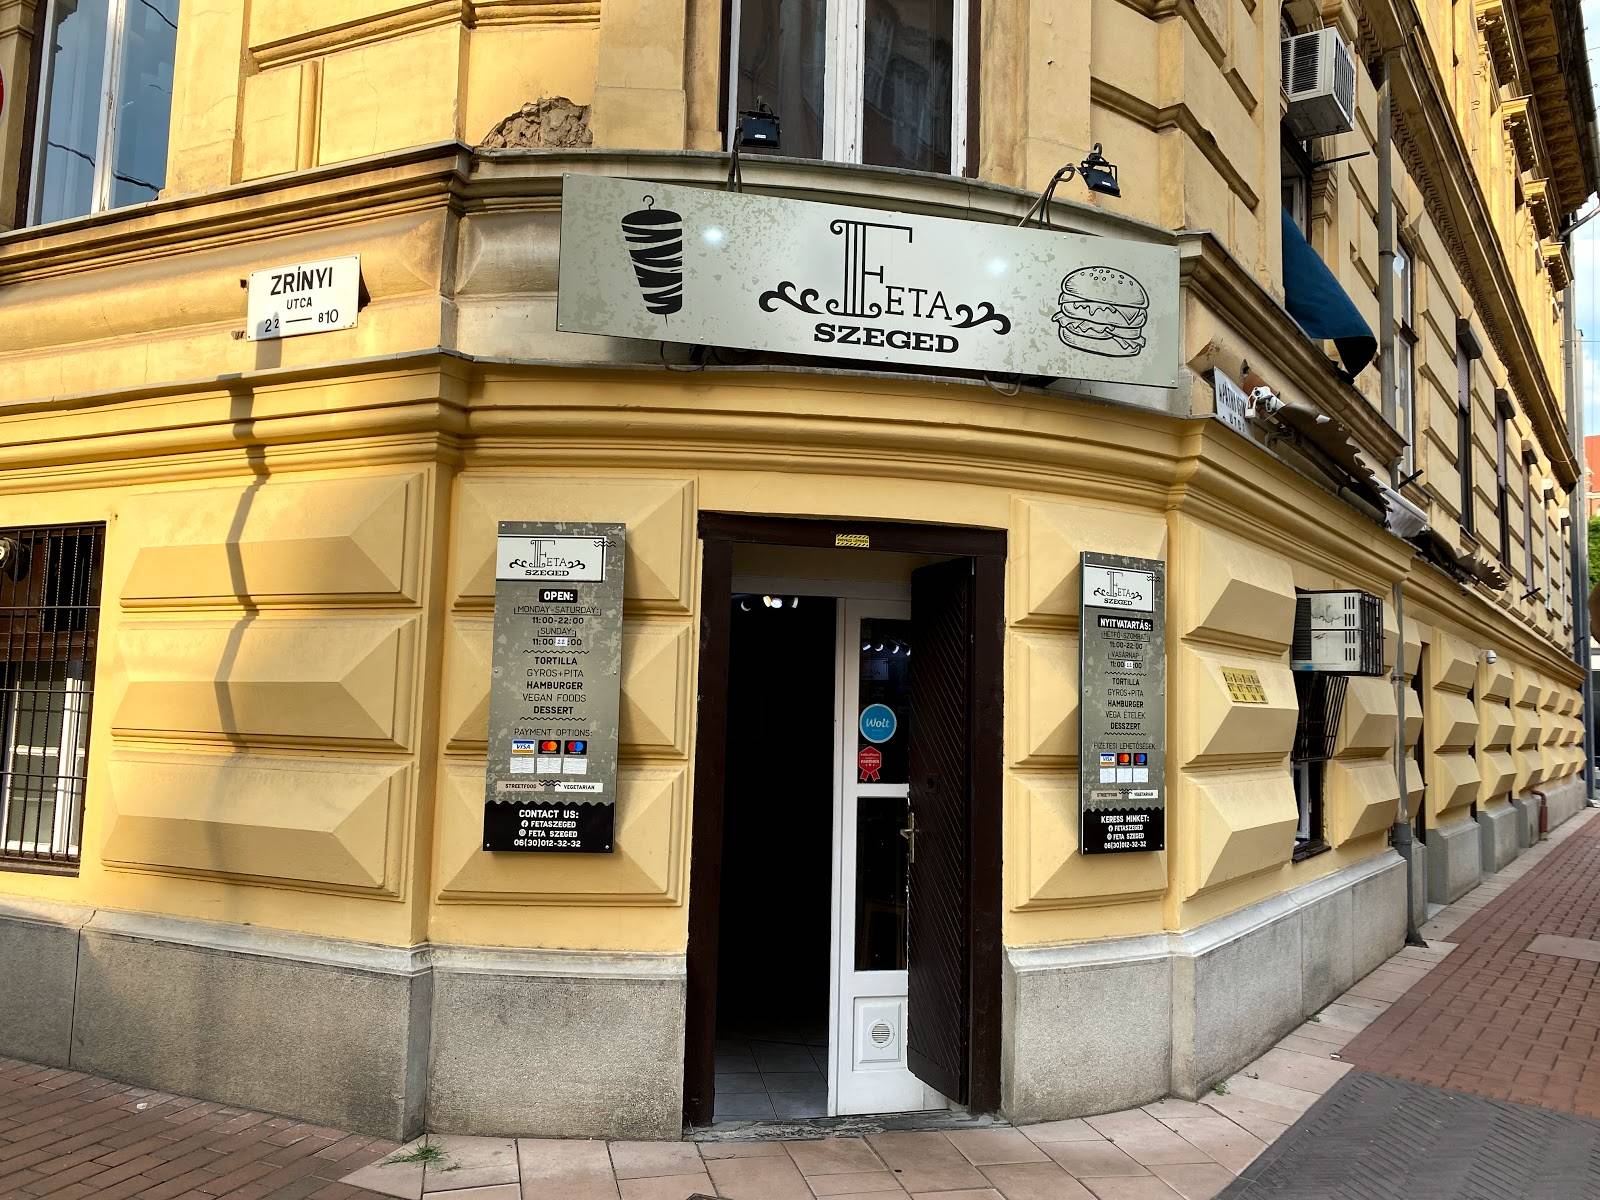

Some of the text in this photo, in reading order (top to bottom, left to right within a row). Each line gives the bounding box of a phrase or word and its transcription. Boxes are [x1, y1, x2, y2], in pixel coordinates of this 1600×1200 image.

[826, 219, 952, 320] FETA
[270, 266, 333, 296] ZRÍNYI
[286, 297, 313, 310] UTCA
[813, 322, 959, 353] SZEGED
[543, 591, 574, 601] OPEN:
[1103, 597, 1133, 606] SZEGED
[1100, 617, 1152, 631] NYITVATARTÁS:
[534, 656, 578, 665] TORTILLA
[526, 669, 584, 678] GYROS+PITA
[526, 681, 583, 690] HAMBURGER
[1112, 677, 1140, 686] TORTILLA
[522, 693, 587, 702] VEGAN FOODS
[1107, 699, 1144, 708] HAMBURGER
[533, 706, 574, 714] DESSERT
[865, 718, 890, 728] Wolt
[1110, 722, 1141, 730] DESSZERT
[514, 728, 593, 737] PAYMENT OPTIONS:
[519, 809, 579, 819] CONTACT US:
[530, 820, 577, 828] FETASZEGED
[1100, 815, 1124, 824] KERESS
[528, 830, 546, 838] FETA
